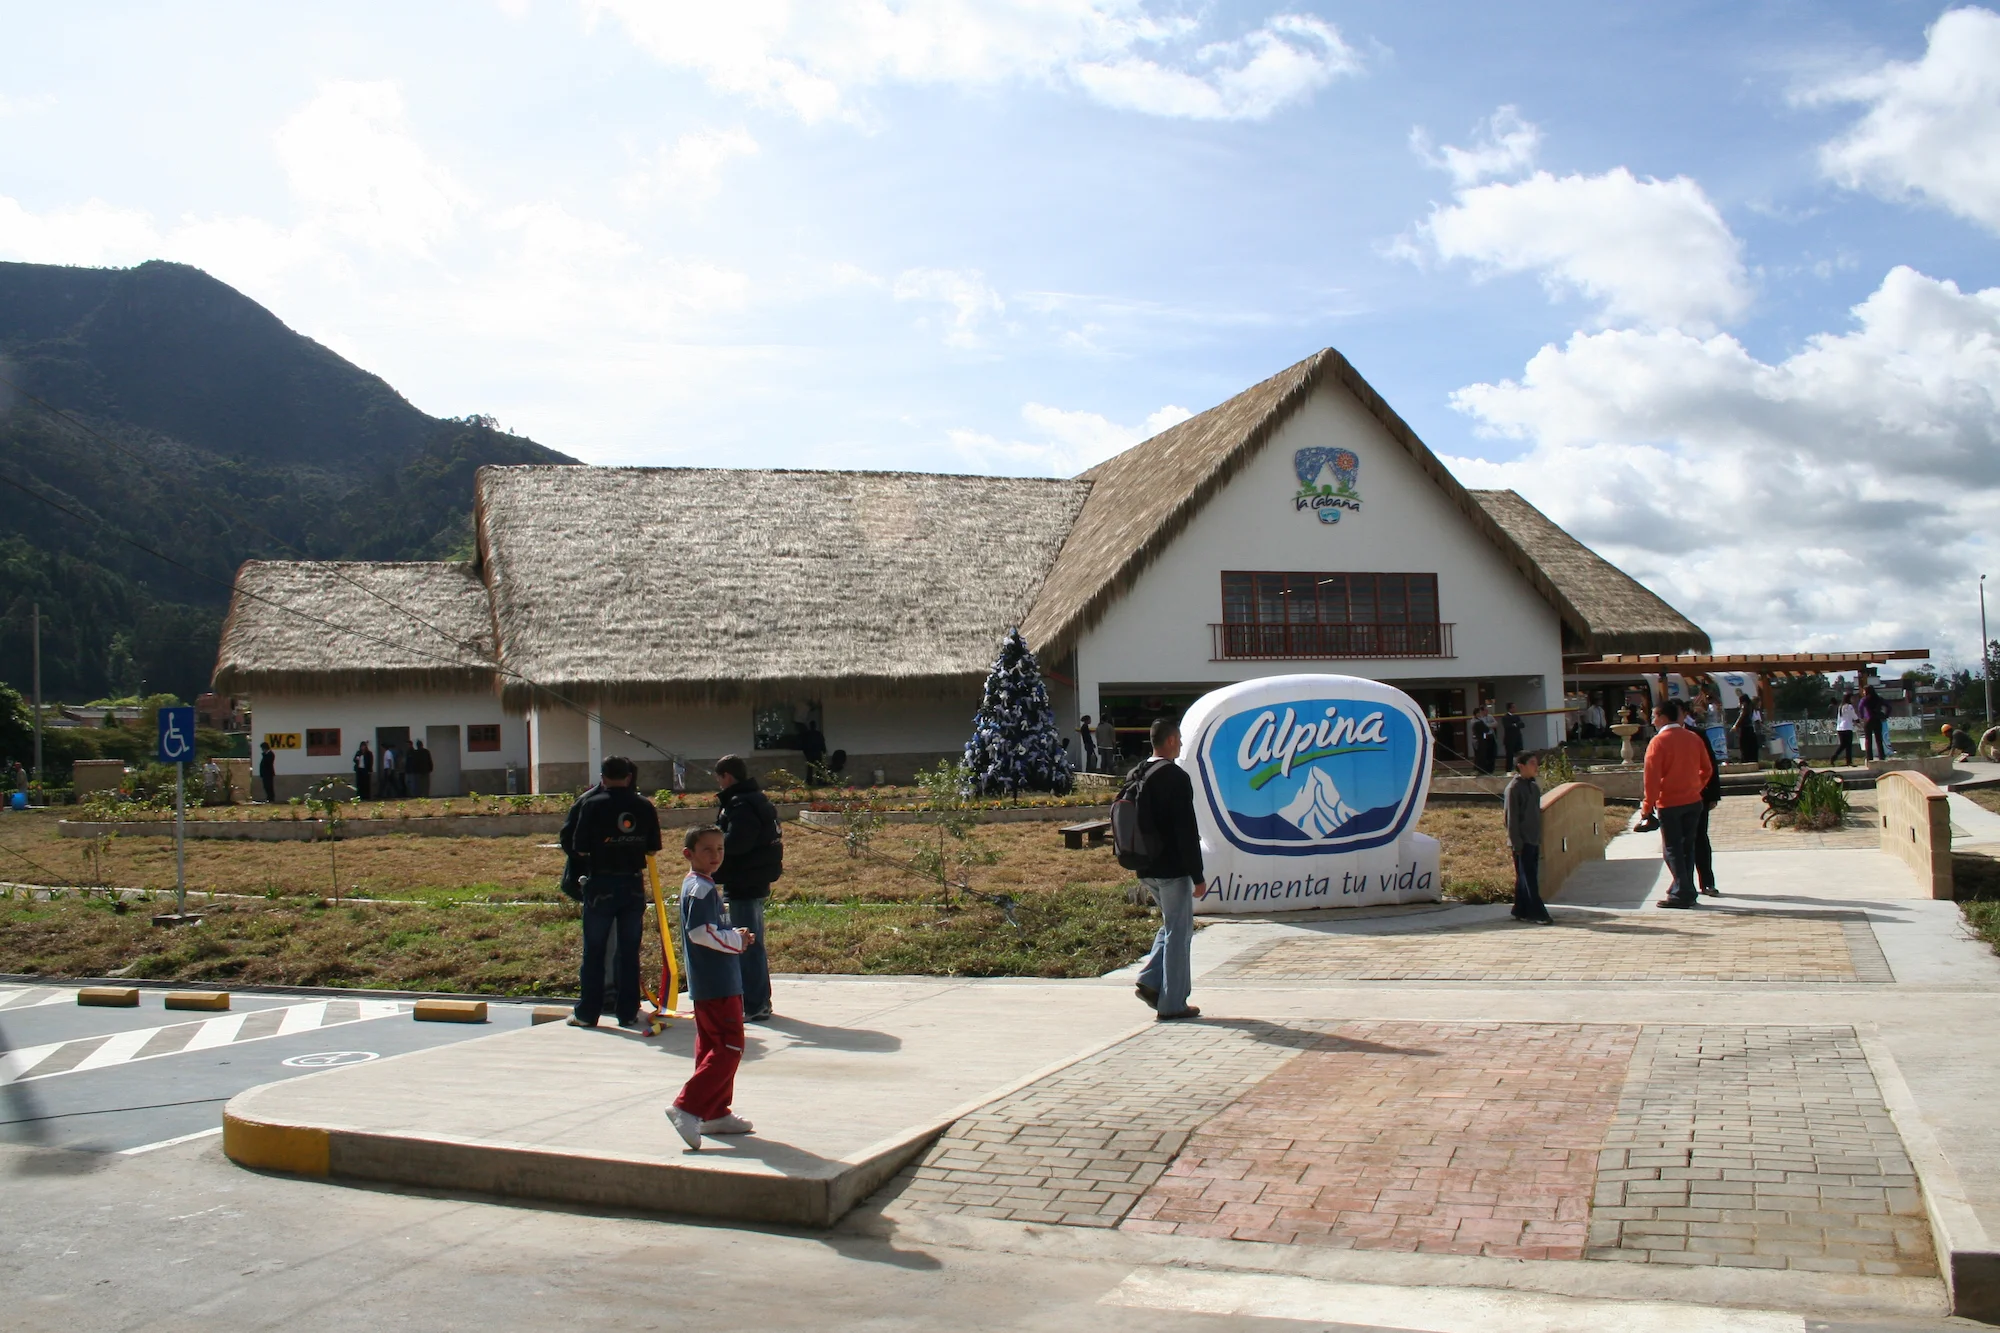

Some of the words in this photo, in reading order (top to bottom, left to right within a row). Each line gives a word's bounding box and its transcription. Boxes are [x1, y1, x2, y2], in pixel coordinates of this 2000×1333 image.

[1201, 872, 1330, 902] Alimenta
[1343, 871, 1367, 895] tu
[1380, 862, 1432, 891] vida
